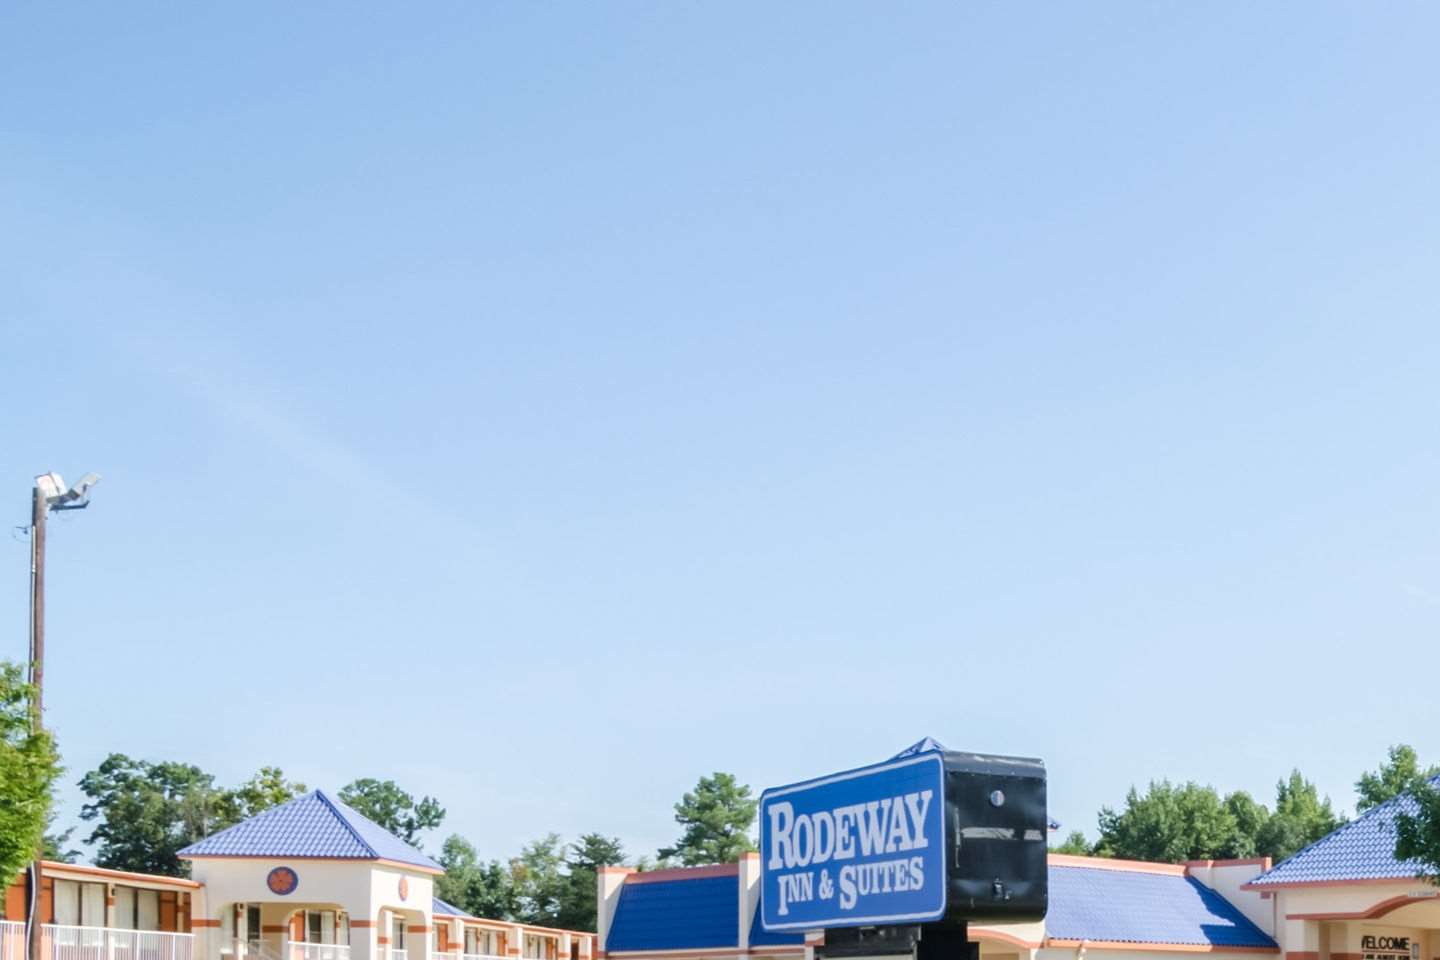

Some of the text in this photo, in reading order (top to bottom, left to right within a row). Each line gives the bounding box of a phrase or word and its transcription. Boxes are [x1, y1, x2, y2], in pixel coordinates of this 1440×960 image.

[767, 789, 933, 871] RODEWAY
[777, 856, 925, 915] INN & SUITES
